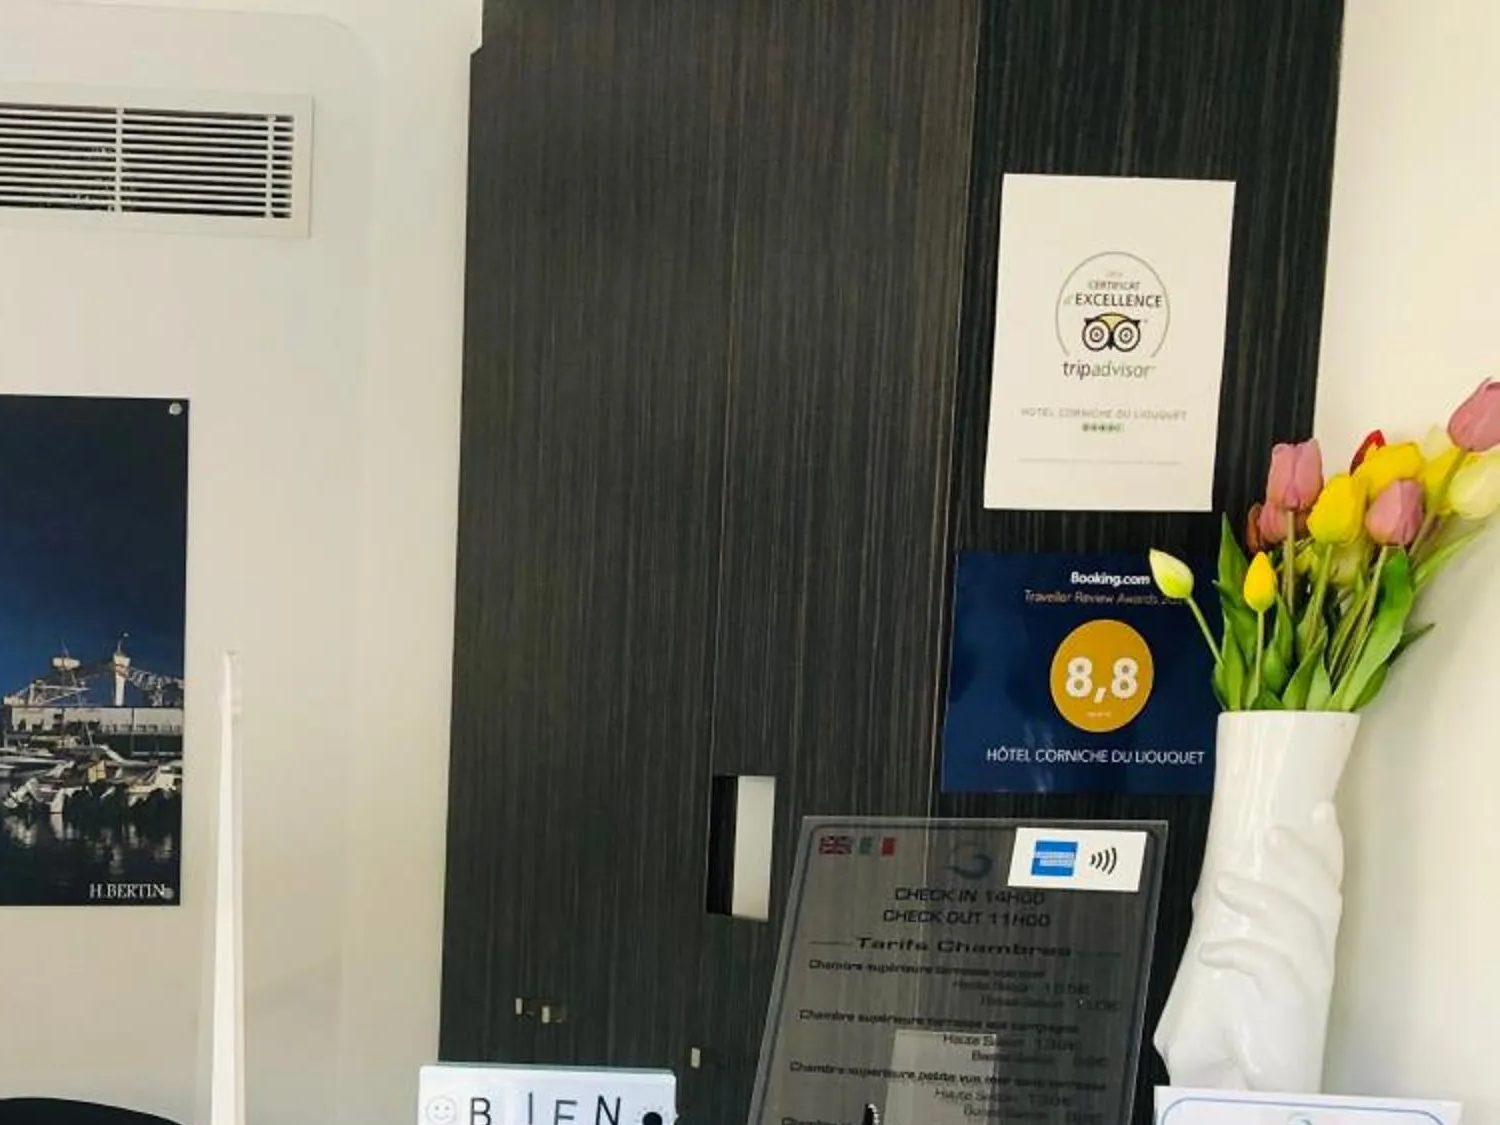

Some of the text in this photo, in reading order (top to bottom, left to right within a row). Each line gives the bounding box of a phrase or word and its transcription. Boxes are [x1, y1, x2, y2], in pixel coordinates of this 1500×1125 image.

[1063, 360, 1150, 380] tripadvisor
[1070, 571, 1151, 588] Booking.com
[1065, 656, 1139, 704] 8,8
[986, 745, 1030, 763] HÔTEL
[1034, 748, 1108, 764] CORNICHE
[1111, 751, 1133, 764] DU
[894, 887, 954, 902] CHECK
[959, 889, 978, 903] IN
[883, 908, 1051, 927] CHECK OUT 11H00
[856, 937, 1073, 958] Tarifs Chambres
[808, 958, 863, 971] Chambre
